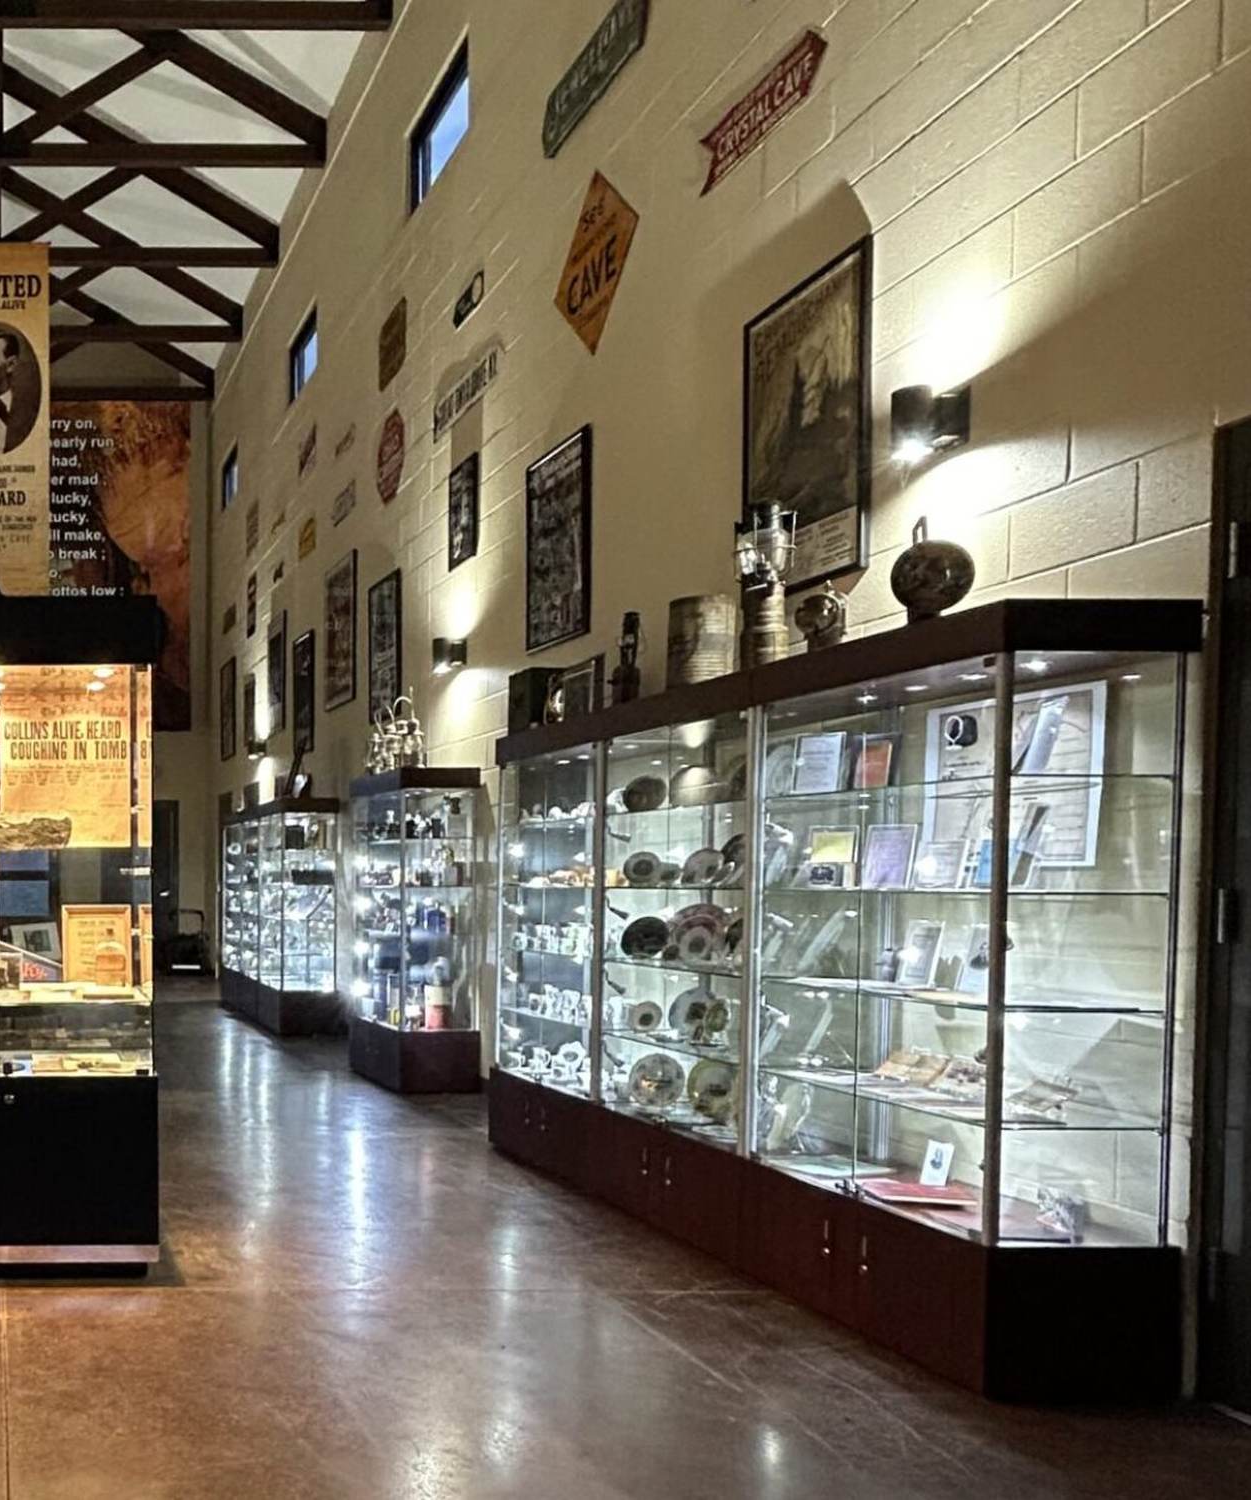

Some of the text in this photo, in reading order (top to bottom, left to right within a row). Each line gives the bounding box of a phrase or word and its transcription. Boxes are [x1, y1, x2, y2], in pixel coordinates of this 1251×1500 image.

[718, 95, 771, 159] CRYSTAL
[774, 52, 813, 107] CAVE
[567, 234, 618, 315] CAVE
[2, 300, 26, 310] ALIVE
[75, 420, 97, 431] on,
[91, 438, 115, 448] run
[68, 472, 99, 486] mad
[51, 492, 92, 507] lucky,
[64, 528, 106, 543] make,
[58, 548, 97, 560] break
[52, 585, 88, 597] ottos
[91, 584, 117, 597] low
[3, 720, 49, 740] COLLINS
[86, 720, 122, 740] HEARD
[10, 740, 127, 760] COUGHING IN TOMB
